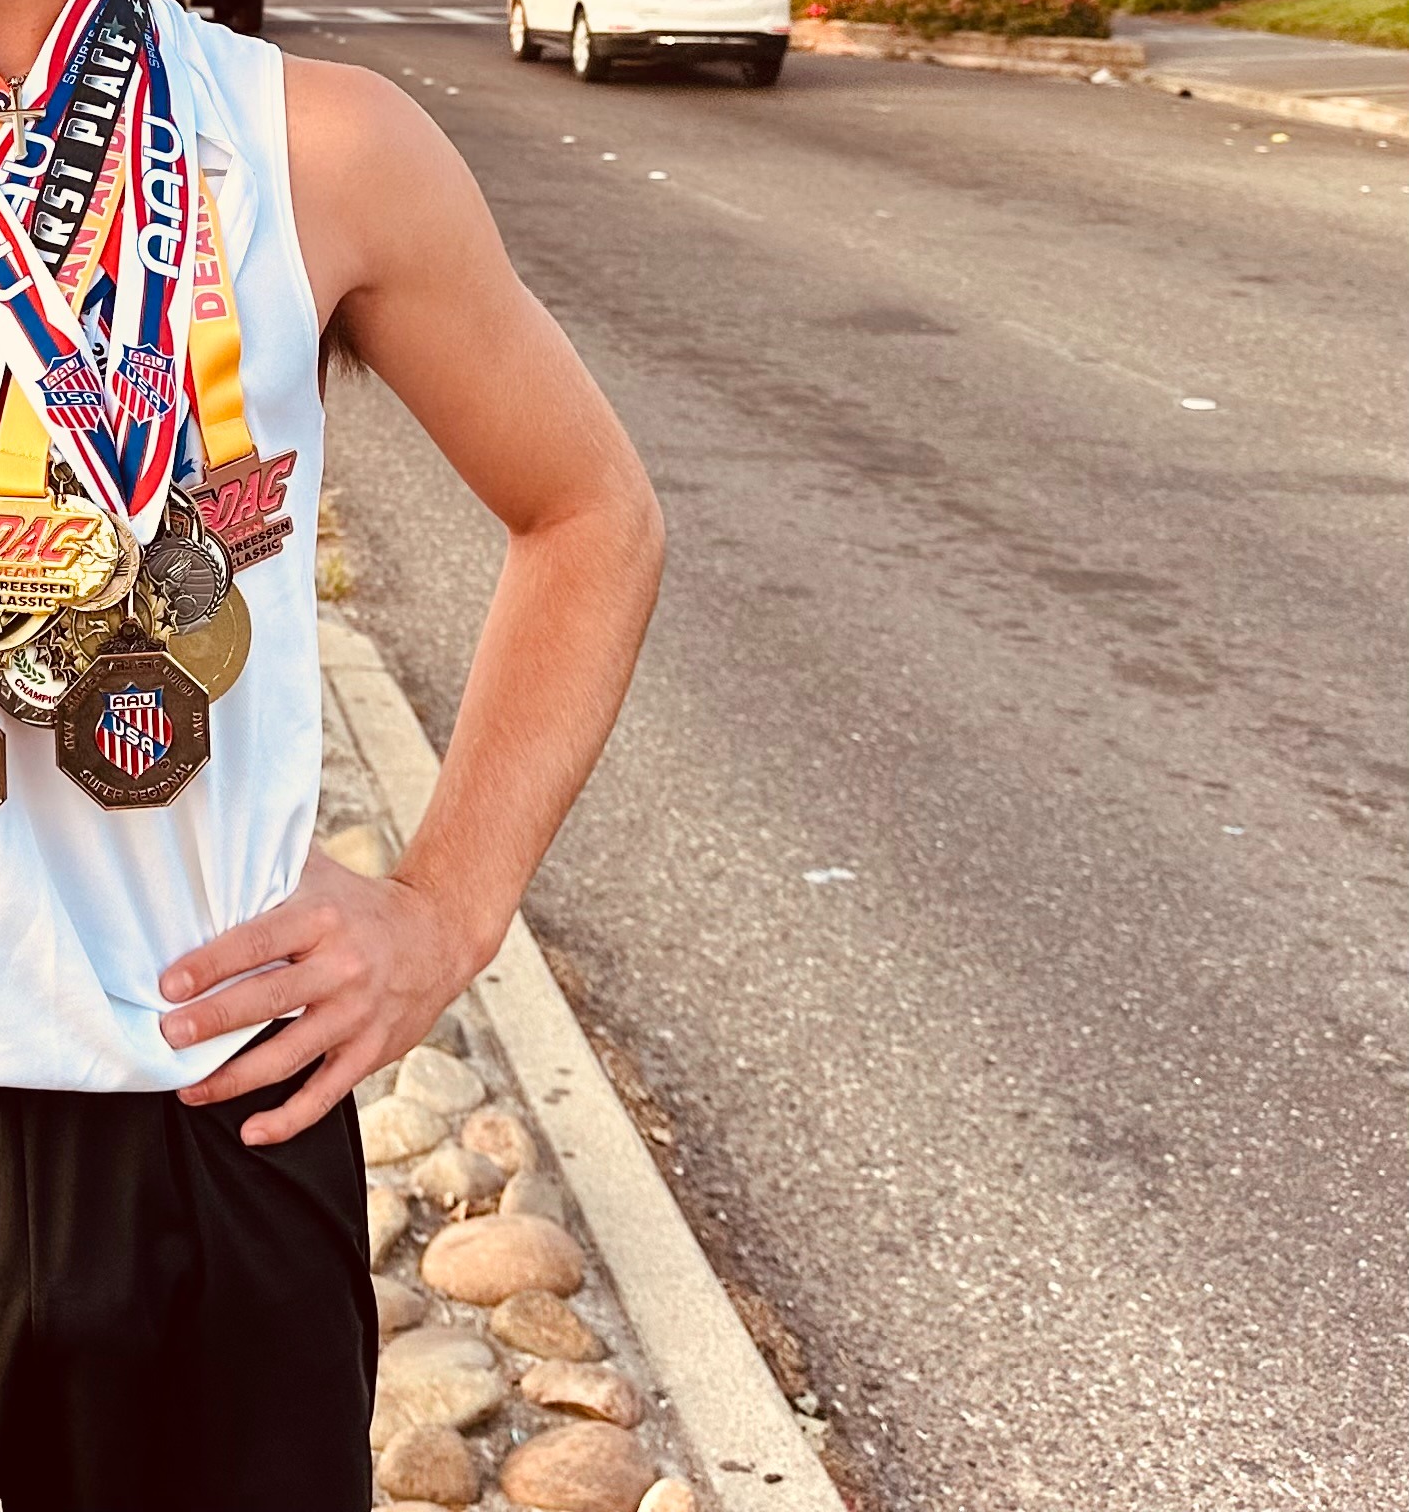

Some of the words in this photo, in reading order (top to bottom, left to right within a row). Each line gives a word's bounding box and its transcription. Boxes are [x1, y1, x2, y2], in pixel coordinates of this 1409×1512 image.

[64, 28, 137, 147] PLACE
[137, 113, 184, 279] AAU
[47, 359, 78, 387] AAU
[131, 351, 165, 368] AAU
[53, 392, 95, 405] USA
[126, 366, 161, 407] USA
[215, 457, 292, 532] DAC
[112, 694, 153, 708] AAU
[112, 714, 154, 758] USA
[79, 769, 124, 799] SUPER
[127, 763, 193, 801] REGIONAL
